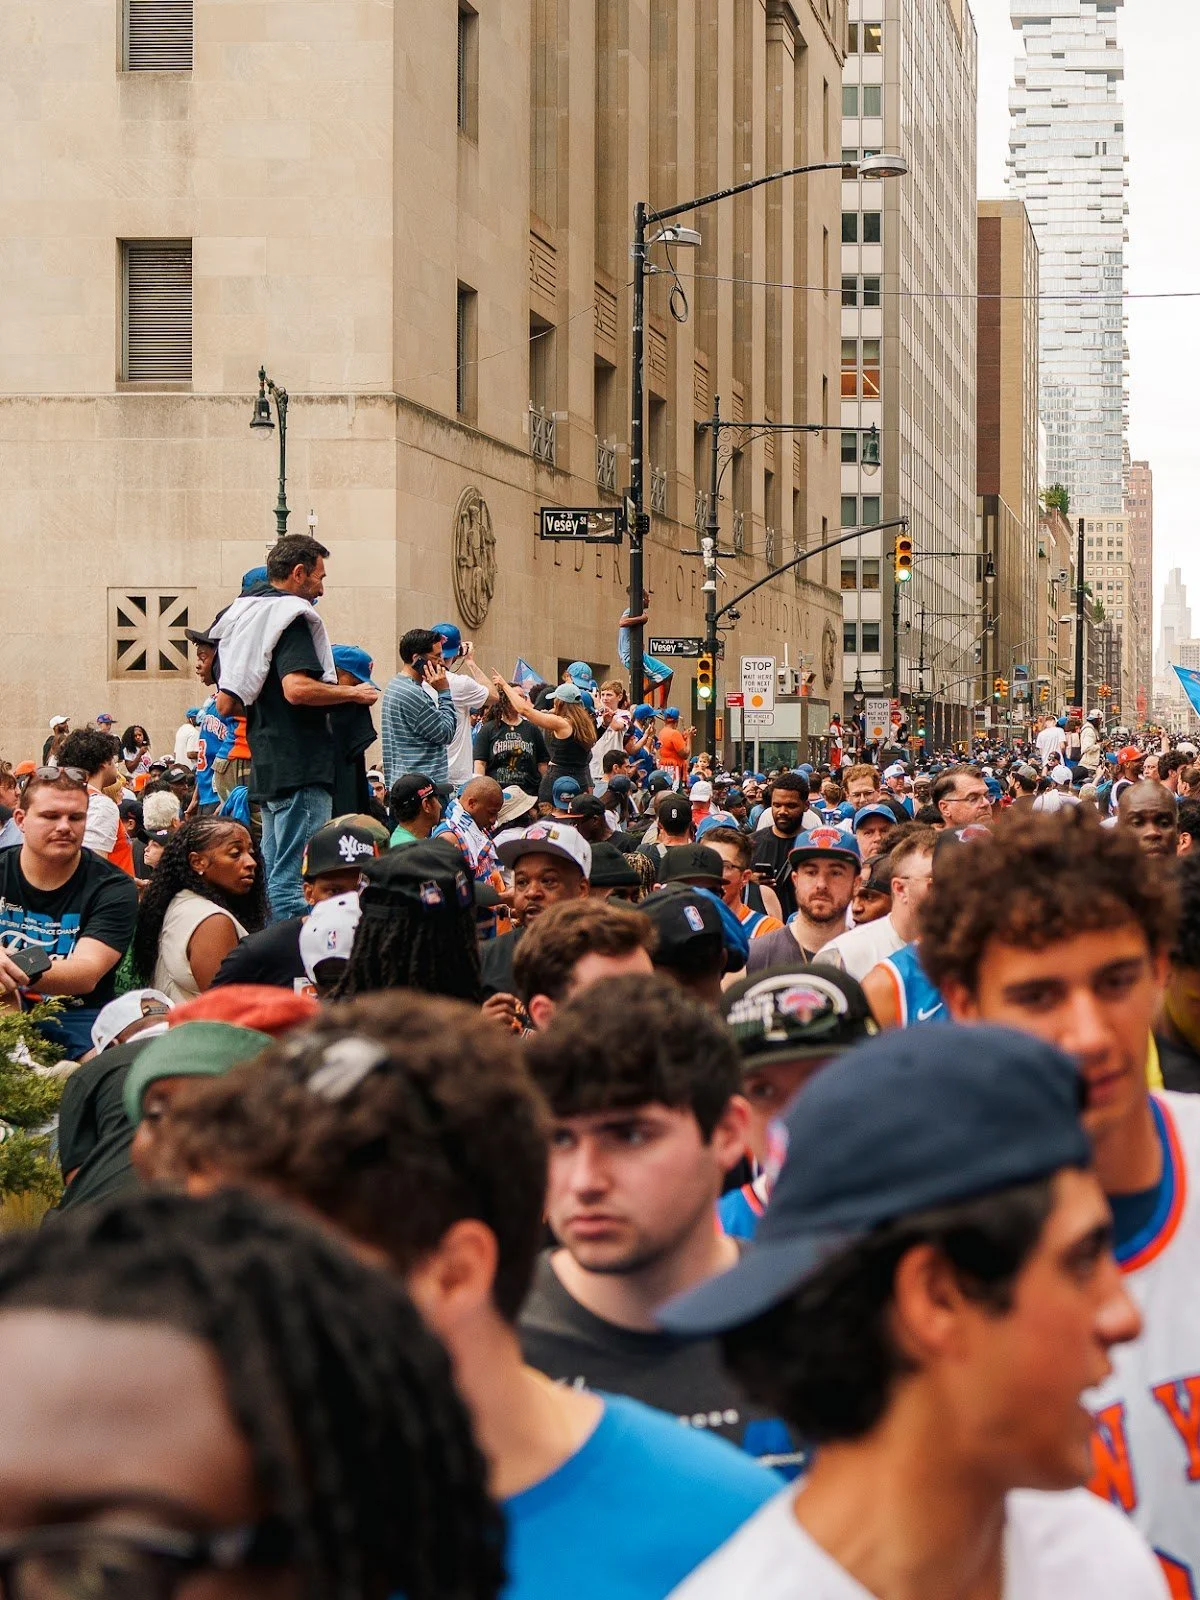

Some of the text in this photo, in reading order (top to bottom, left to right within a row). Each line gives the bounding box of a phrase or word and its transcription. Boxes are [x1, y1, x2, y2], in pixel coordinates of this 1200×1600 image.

[546, 516, 578, 535] Vesey
[533, 512, 654, 594] FEDERL
[652, 641, 677, 654] Vesey
[744, 661, 772, 671] STOP
[56, 925, 80, 935] CHAMP
